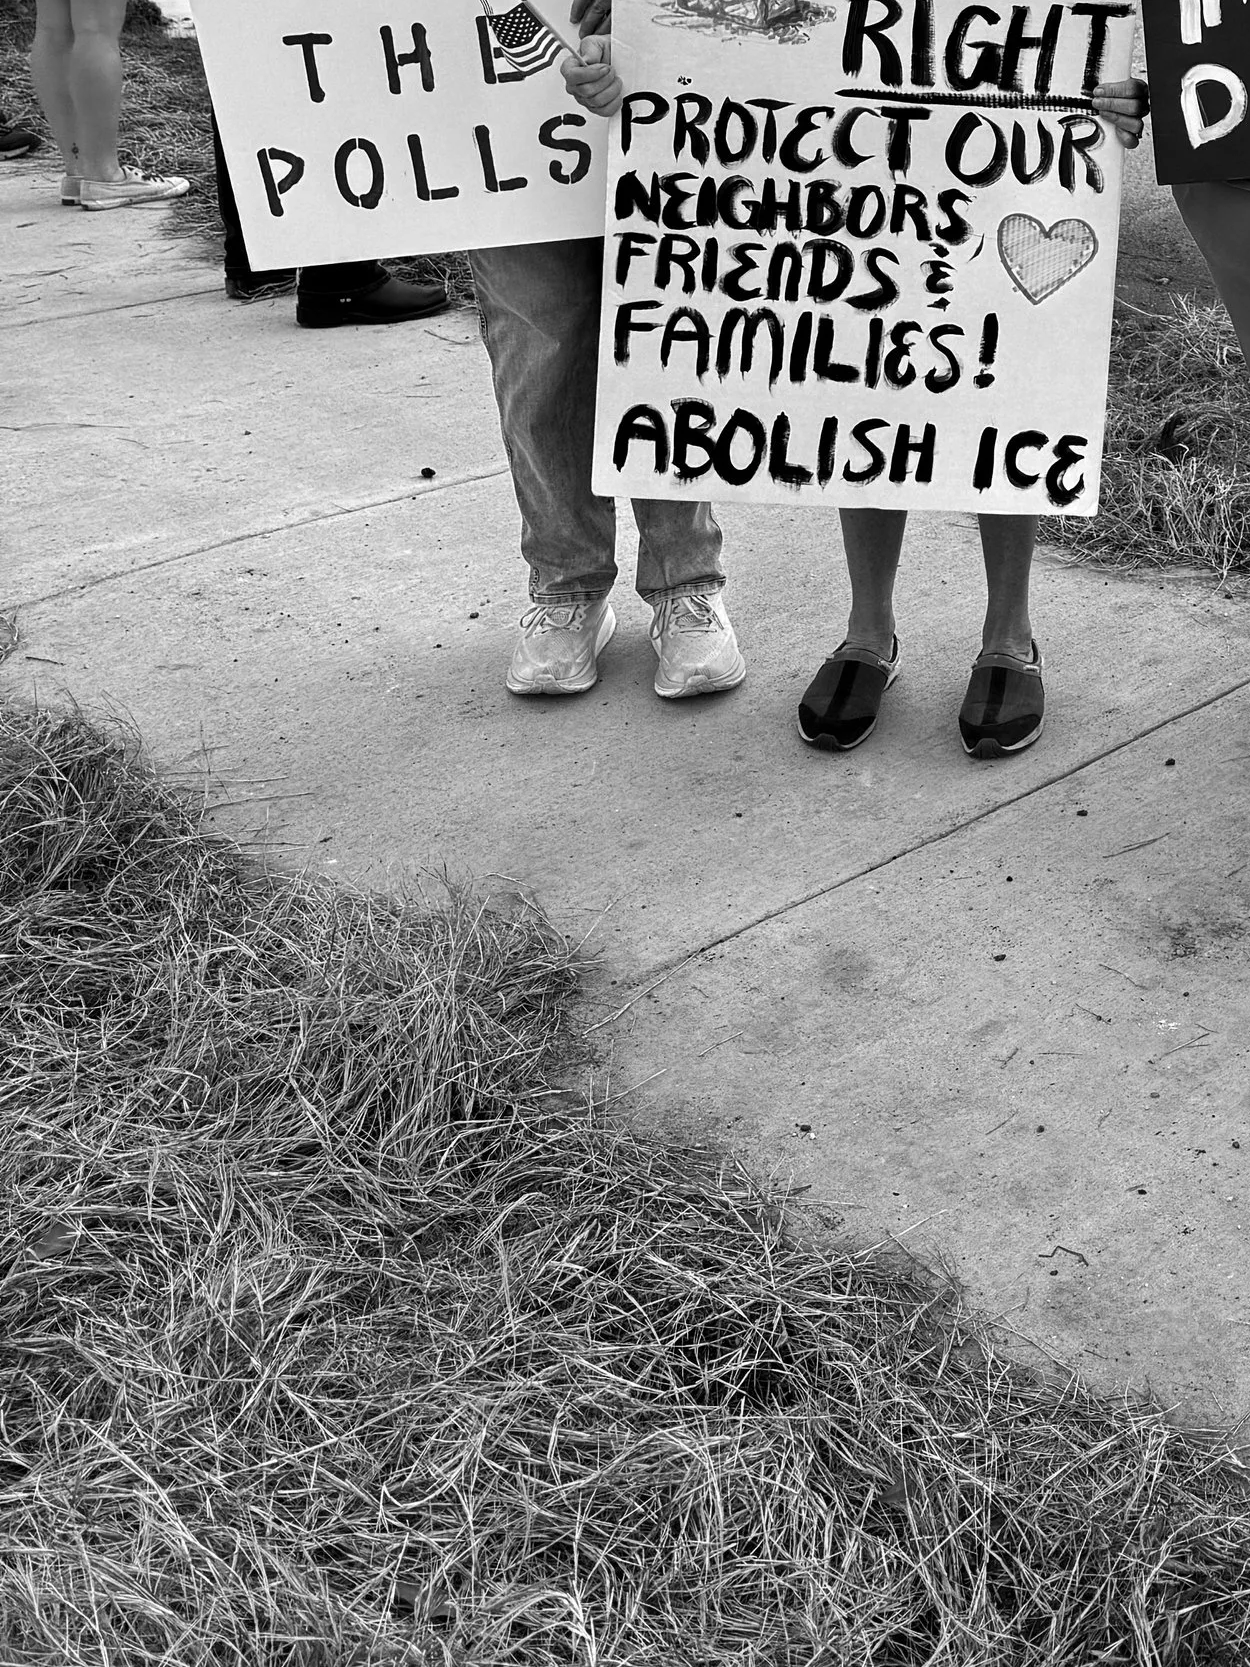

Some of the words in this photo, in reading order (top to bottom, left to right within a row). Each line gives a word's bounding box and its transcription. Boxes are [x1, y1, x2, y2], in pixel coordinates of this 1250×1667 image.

[282, 16, 526, 103] THE
[256, 113, 592, 217] POLLS
[620, 89, 933, 179] PROTECT
[945, 110, 1106, 194] OUR
[614, 232, 901, 312] FRIENDS
[613, 299, 1001, 395] FAMILIES!
[611, 398, 937, 486] ABOLISH
[971, 424, 1090, 507] ICE
